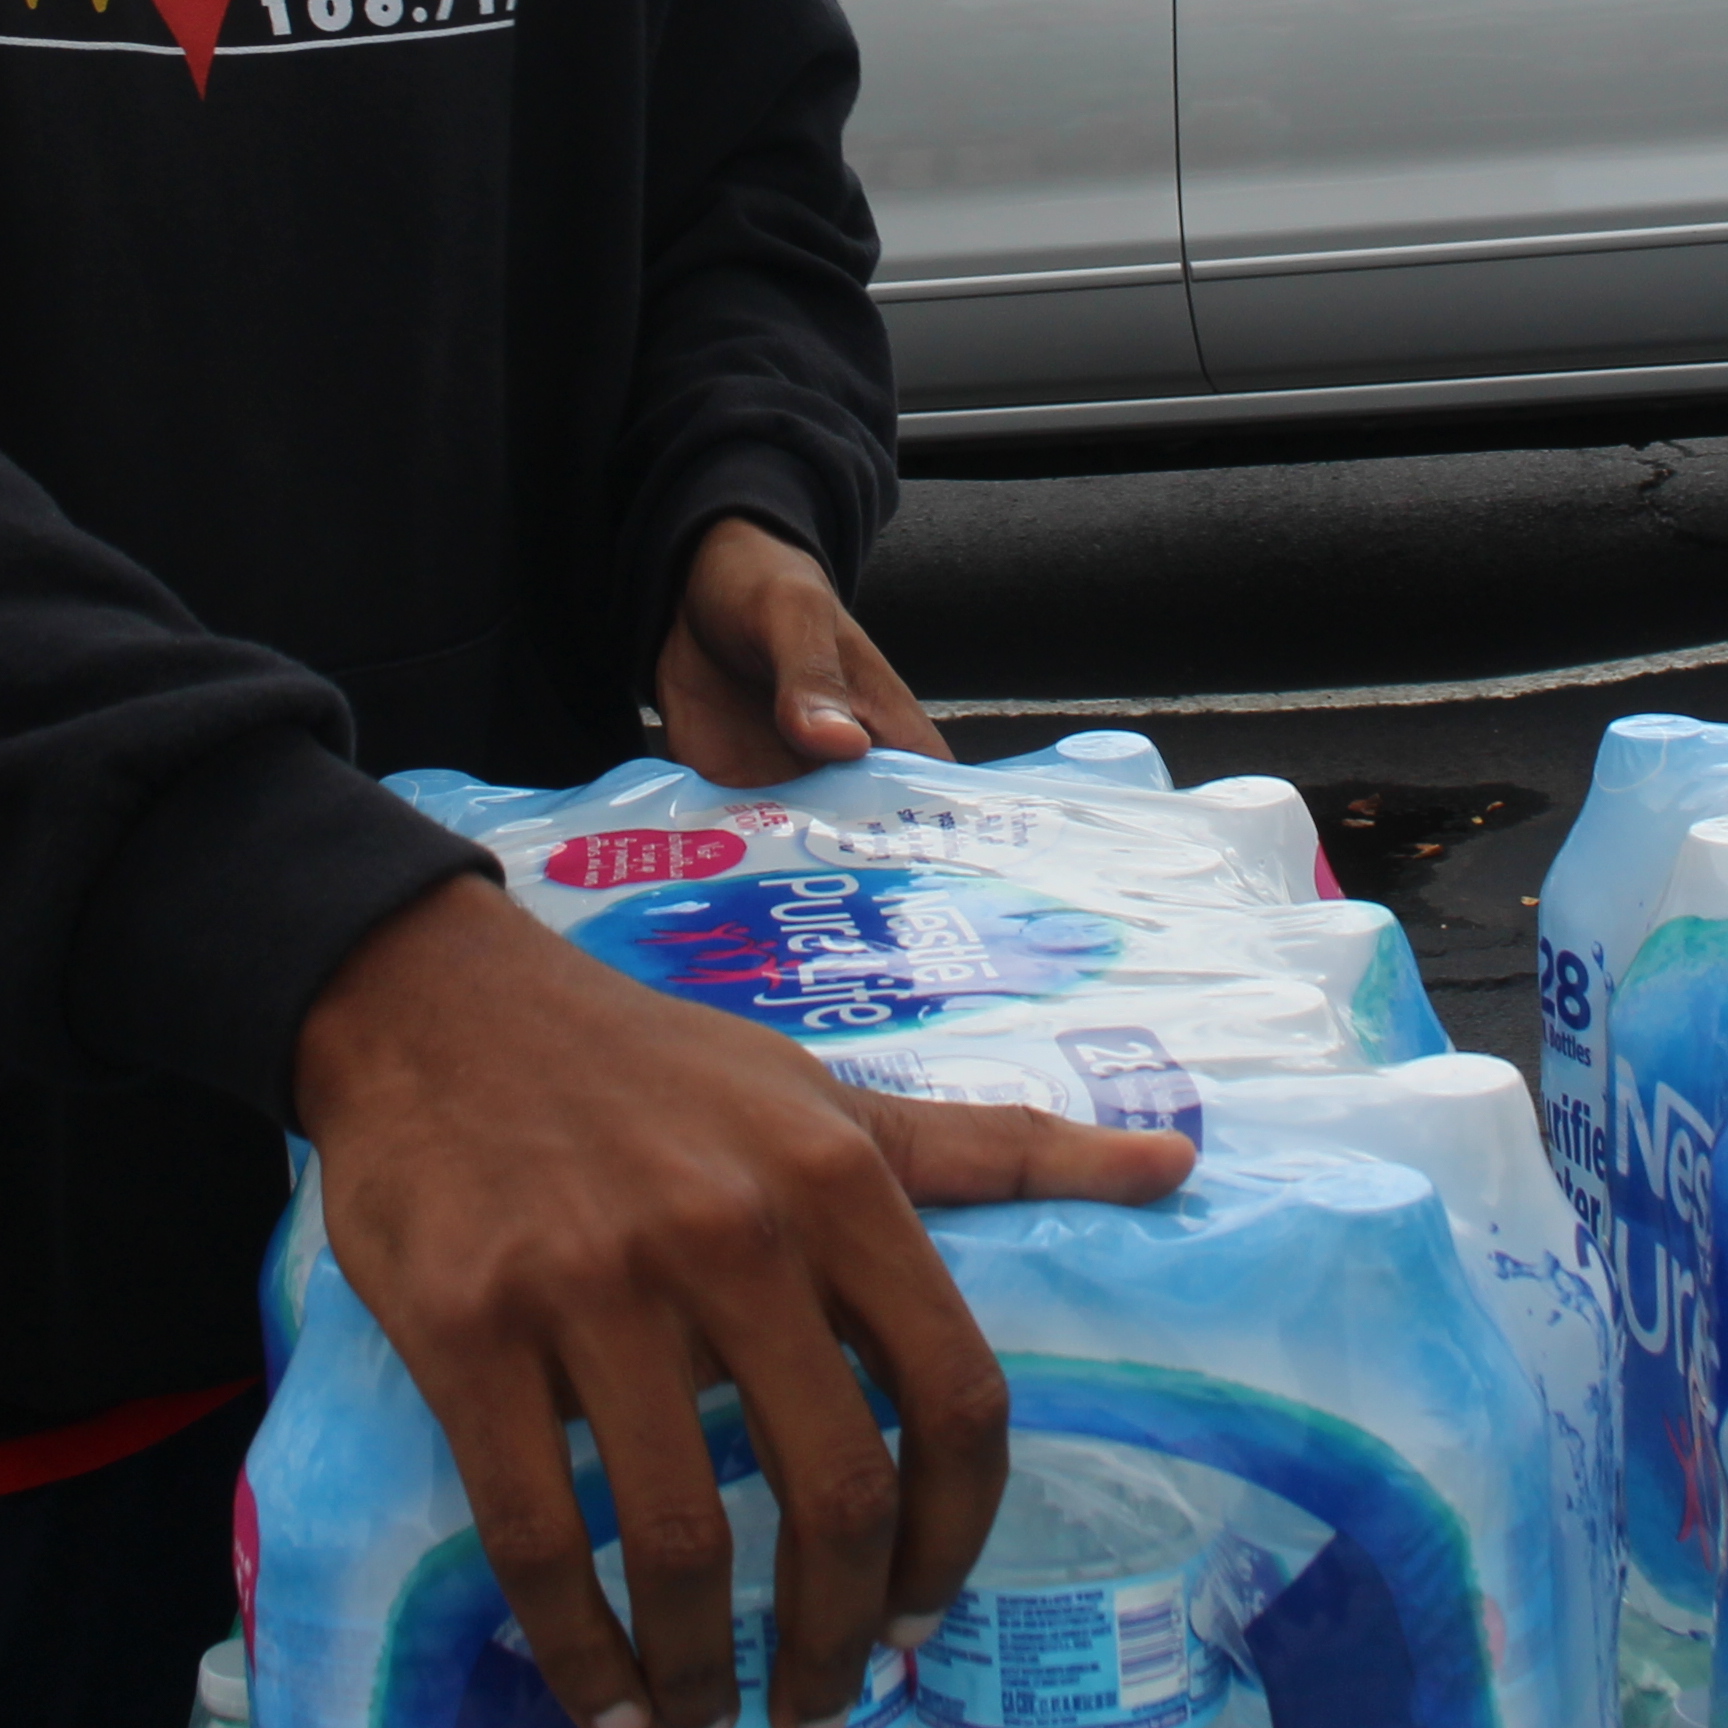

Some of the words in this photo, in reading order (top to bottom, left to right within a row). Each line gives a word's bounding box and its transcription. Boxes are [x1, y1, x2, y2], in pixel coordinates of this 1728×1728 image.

[758, 873, 870, 953] Pure
[871, 888, 1000, 984] Nestlé
[753, 957, 914, 1030] Life
[1539, 934, 1592, 1032] 28
